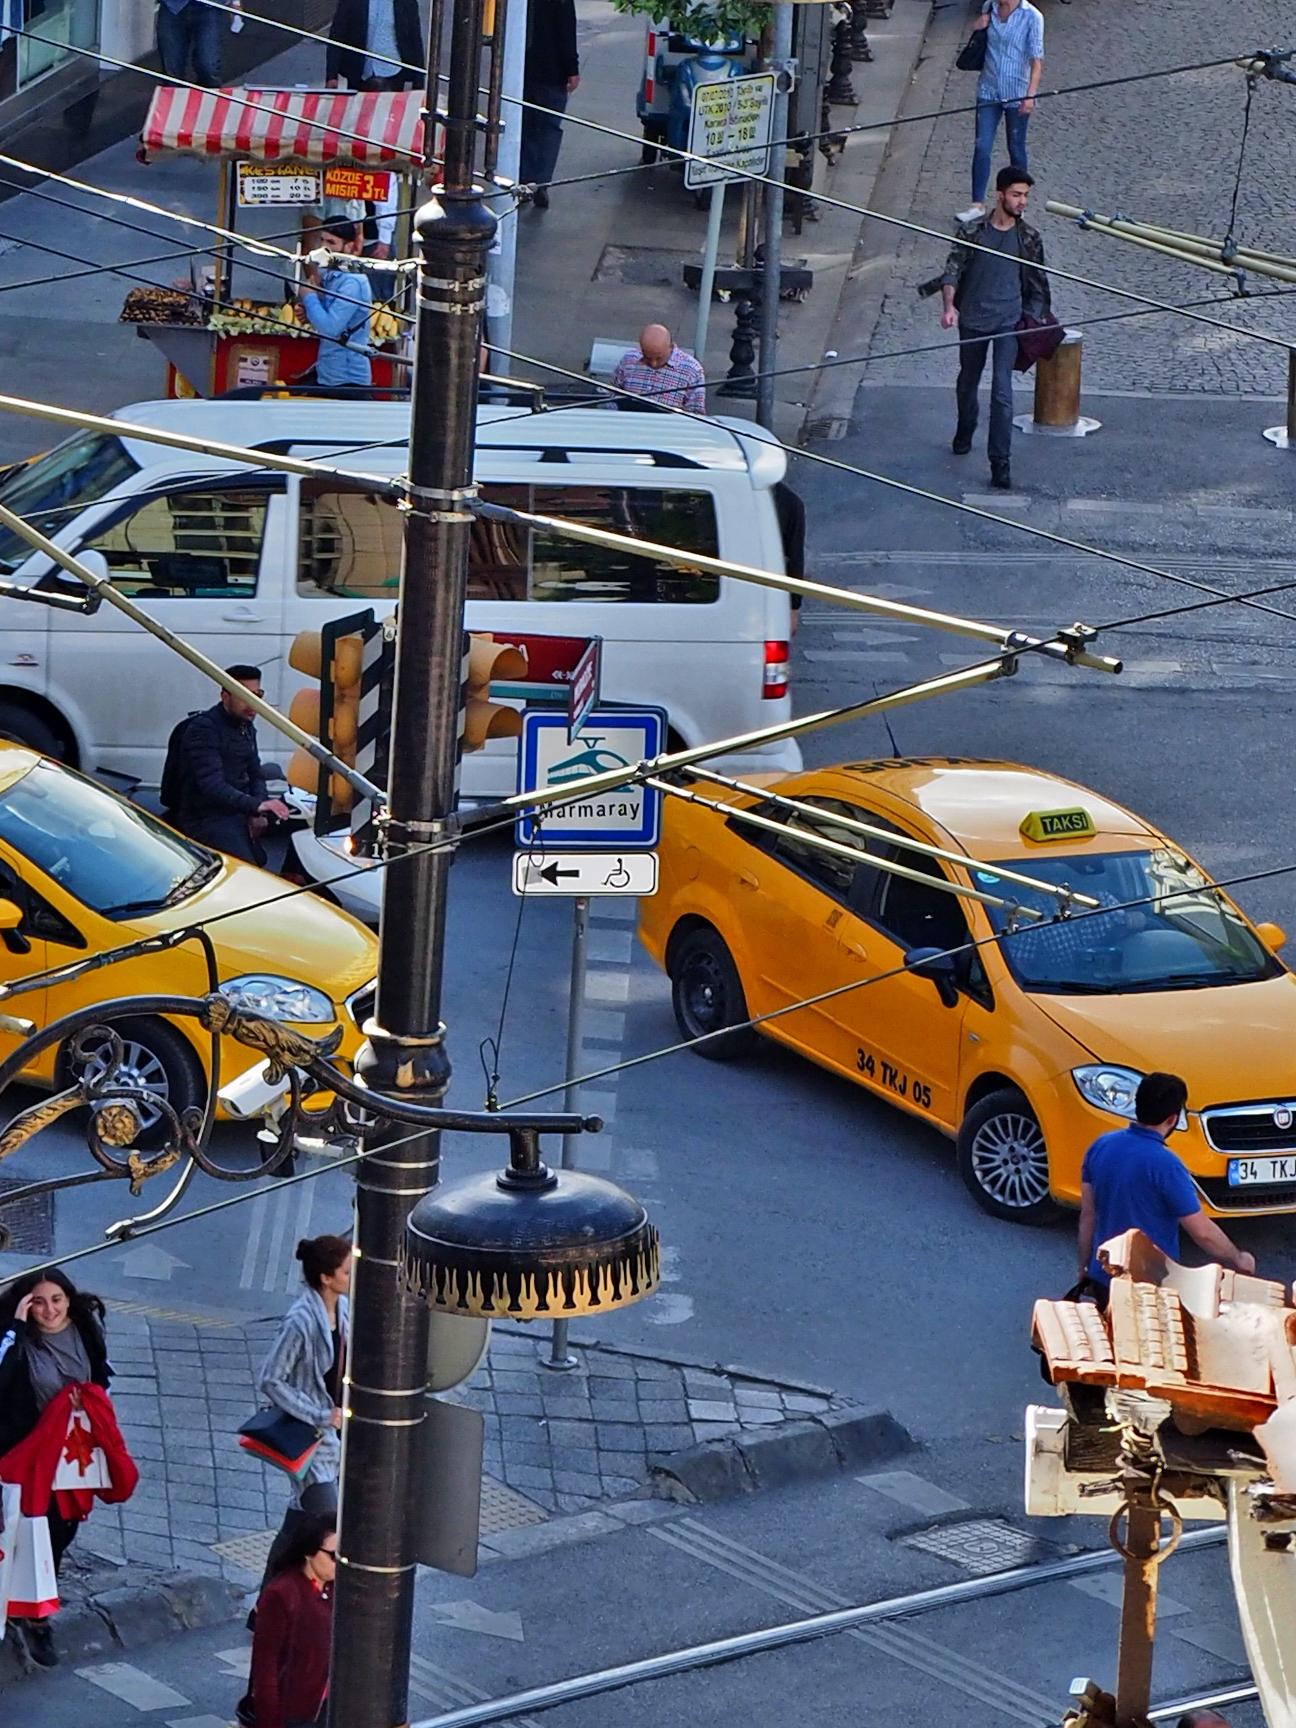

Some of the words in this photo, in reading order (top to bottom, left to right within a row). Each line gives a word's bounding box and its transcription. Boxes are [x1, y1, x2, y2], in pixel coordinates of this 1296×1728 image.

[324, 183, 358, 197] MISIR
[539, 800, 641, 821] Marmaray
[1041, 813, 1089, 834] TAKSİ
[856, 1046, 876, 1079] 34
[880, 1060, 907, 1096] TKJ
[911, 1079, 932, 1109] 05
[1239, 1160, 1258, 1180] 34
